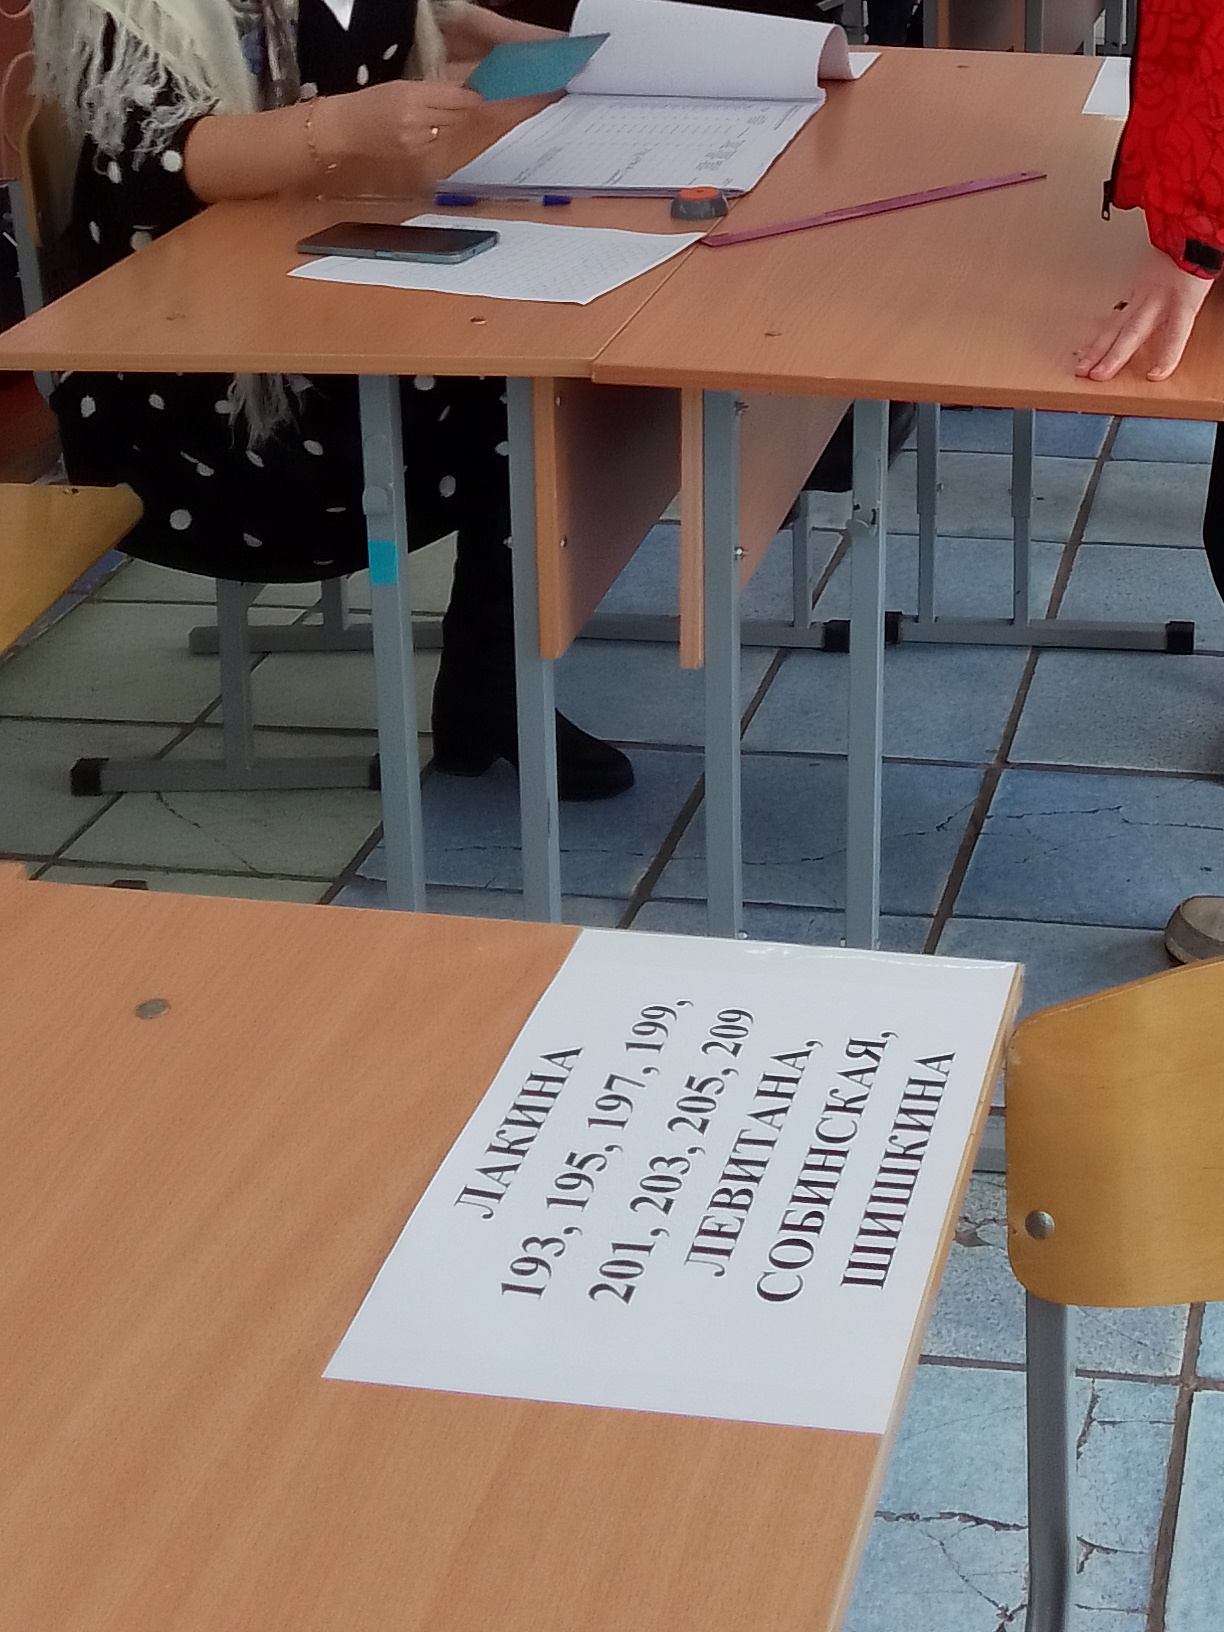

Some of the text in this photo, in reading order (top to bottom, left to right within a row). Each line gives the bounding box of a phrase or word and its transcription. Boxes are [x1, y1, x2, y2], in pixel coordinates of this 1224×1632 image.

[454, 1047, 584, 1220] ЛАКИНА
[500, 999, 695, 1300] 193, 195, 197, 199,
[588, 1007, 755, 1305] 201, 203, 205, 209
[684, 1039, 824, 1278] ЛЕВИТАНА,
[756, 1030, 900, 1303] СОБИНСКАЯ,
[839, 1051, 958, 1290] ШИШКИНА
